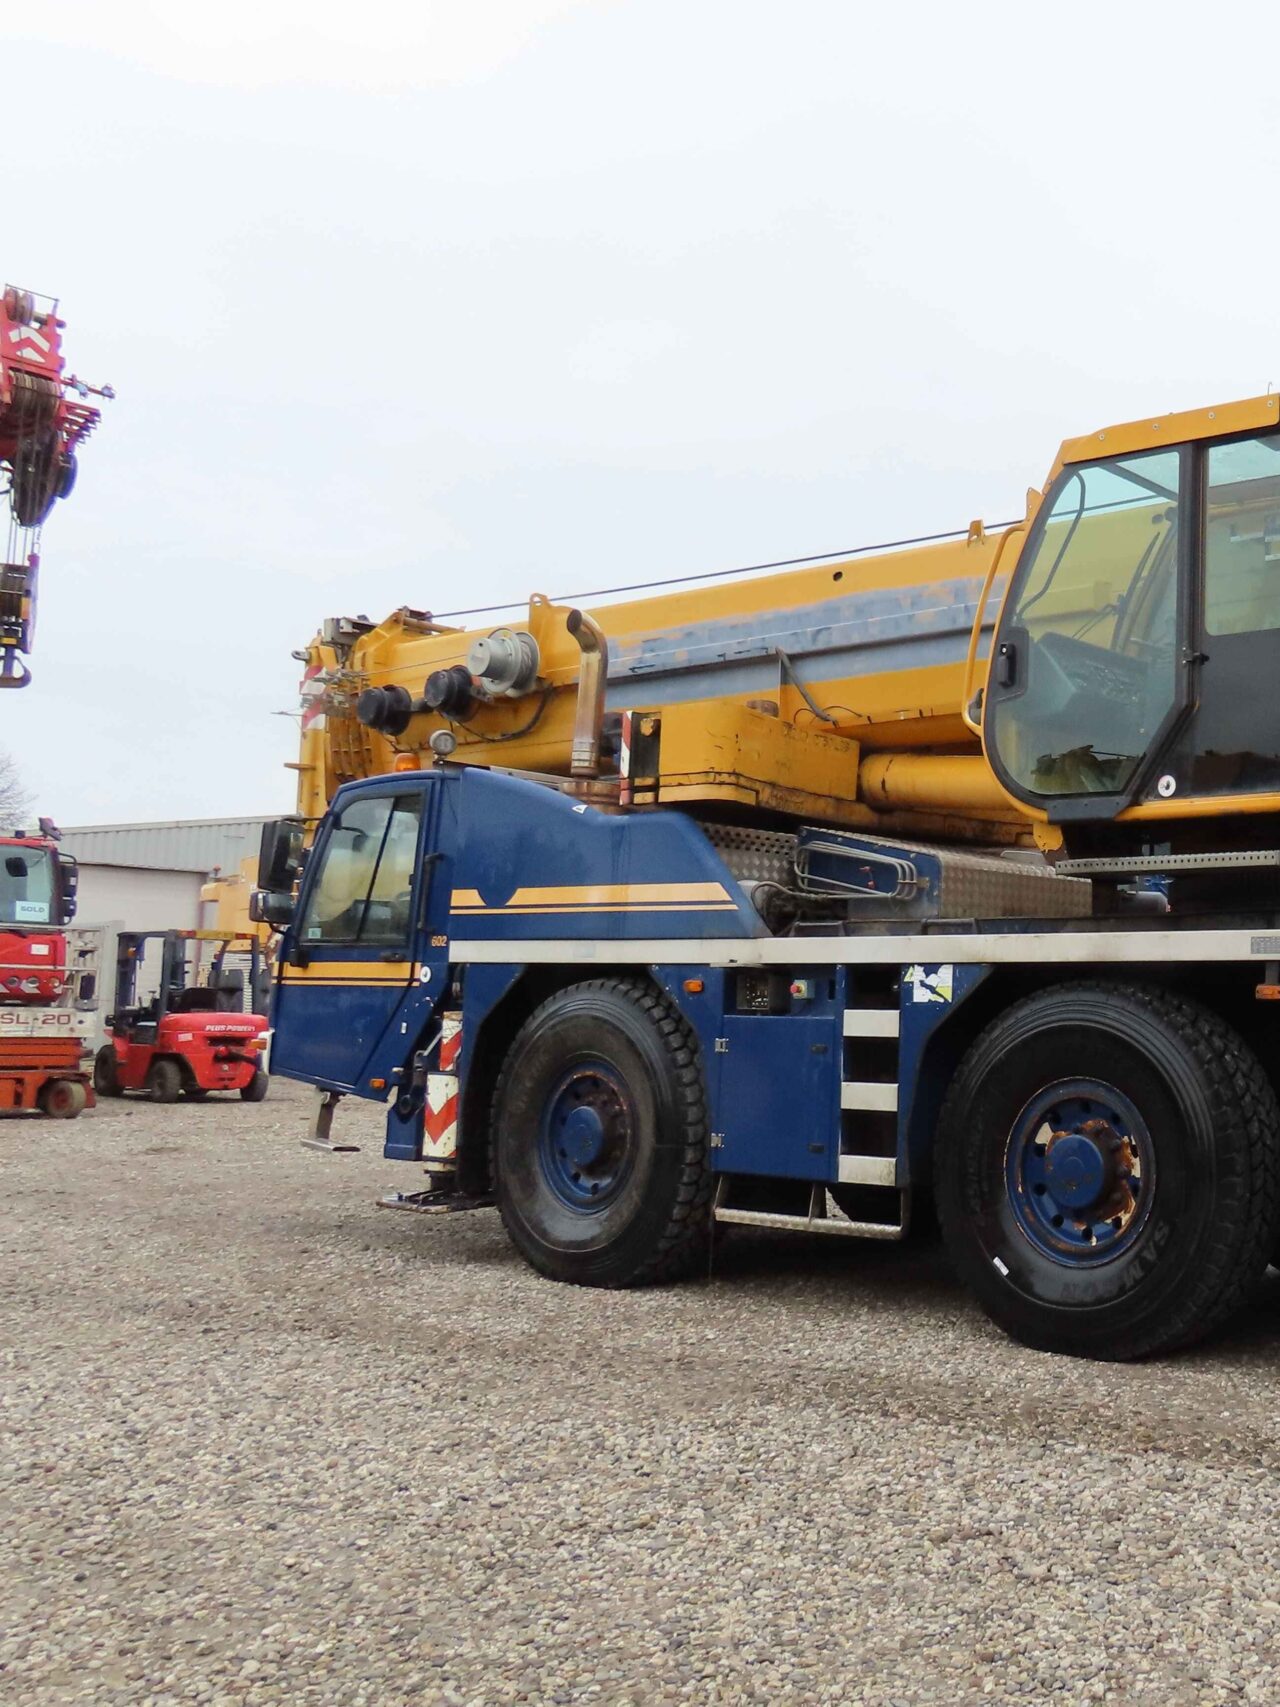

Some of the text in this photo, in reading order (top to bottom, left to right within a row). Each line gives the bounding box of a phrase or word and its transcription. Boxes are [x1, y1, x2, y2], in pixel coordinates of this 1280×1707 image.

[20, 905, 46, 913] SOLD
[431, 935, 448, 947] 602
[205, 1024, 226, 1032] PLUS
